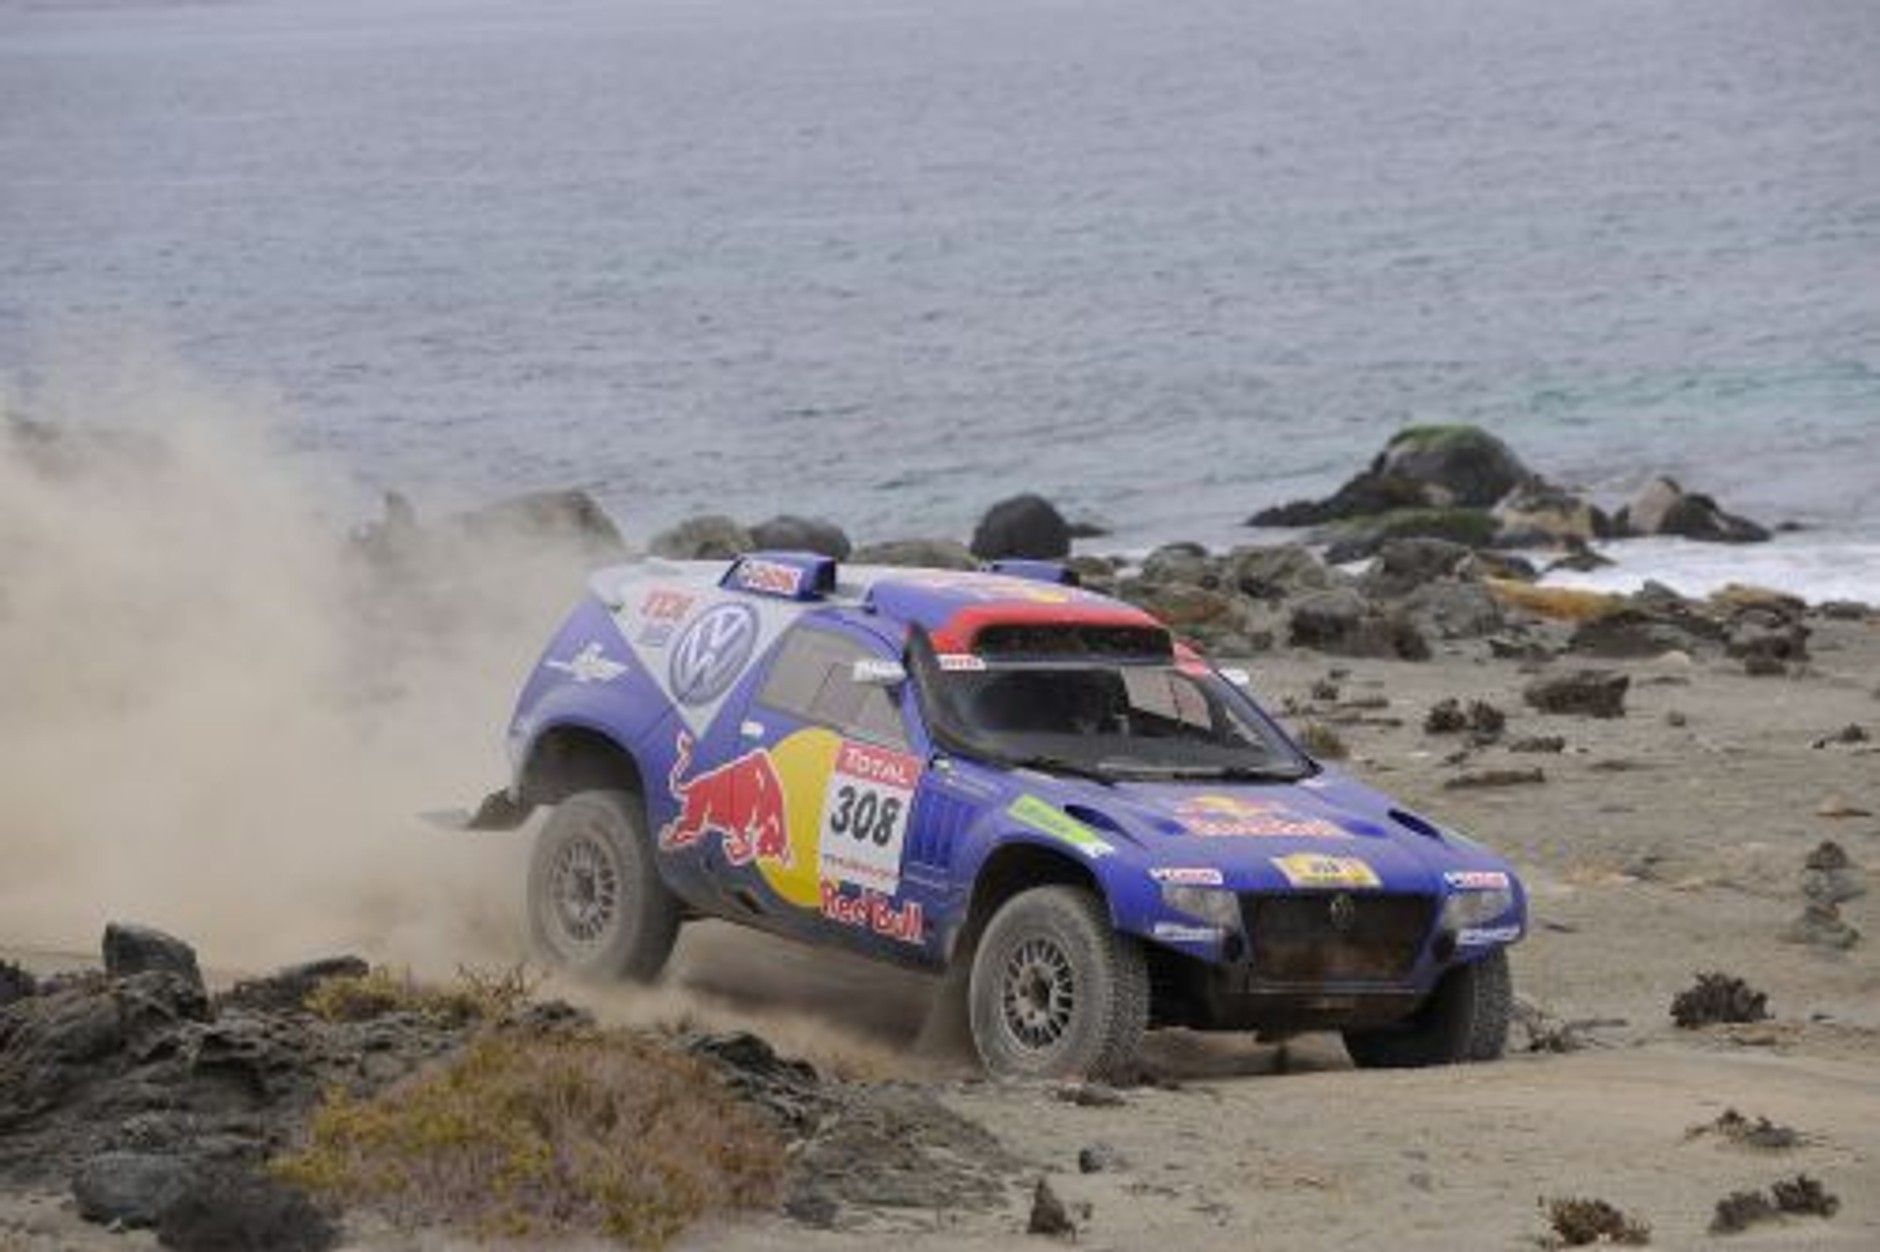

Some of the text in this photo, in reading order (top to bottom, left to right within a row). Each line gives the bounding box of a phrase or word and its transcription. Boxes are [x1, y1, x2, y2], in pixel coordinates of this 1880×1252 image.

[845, 747, 908, 785] TOTAL
[831, 786, 900, 846] 308
[820, 880, 923, 943] Red Bull
